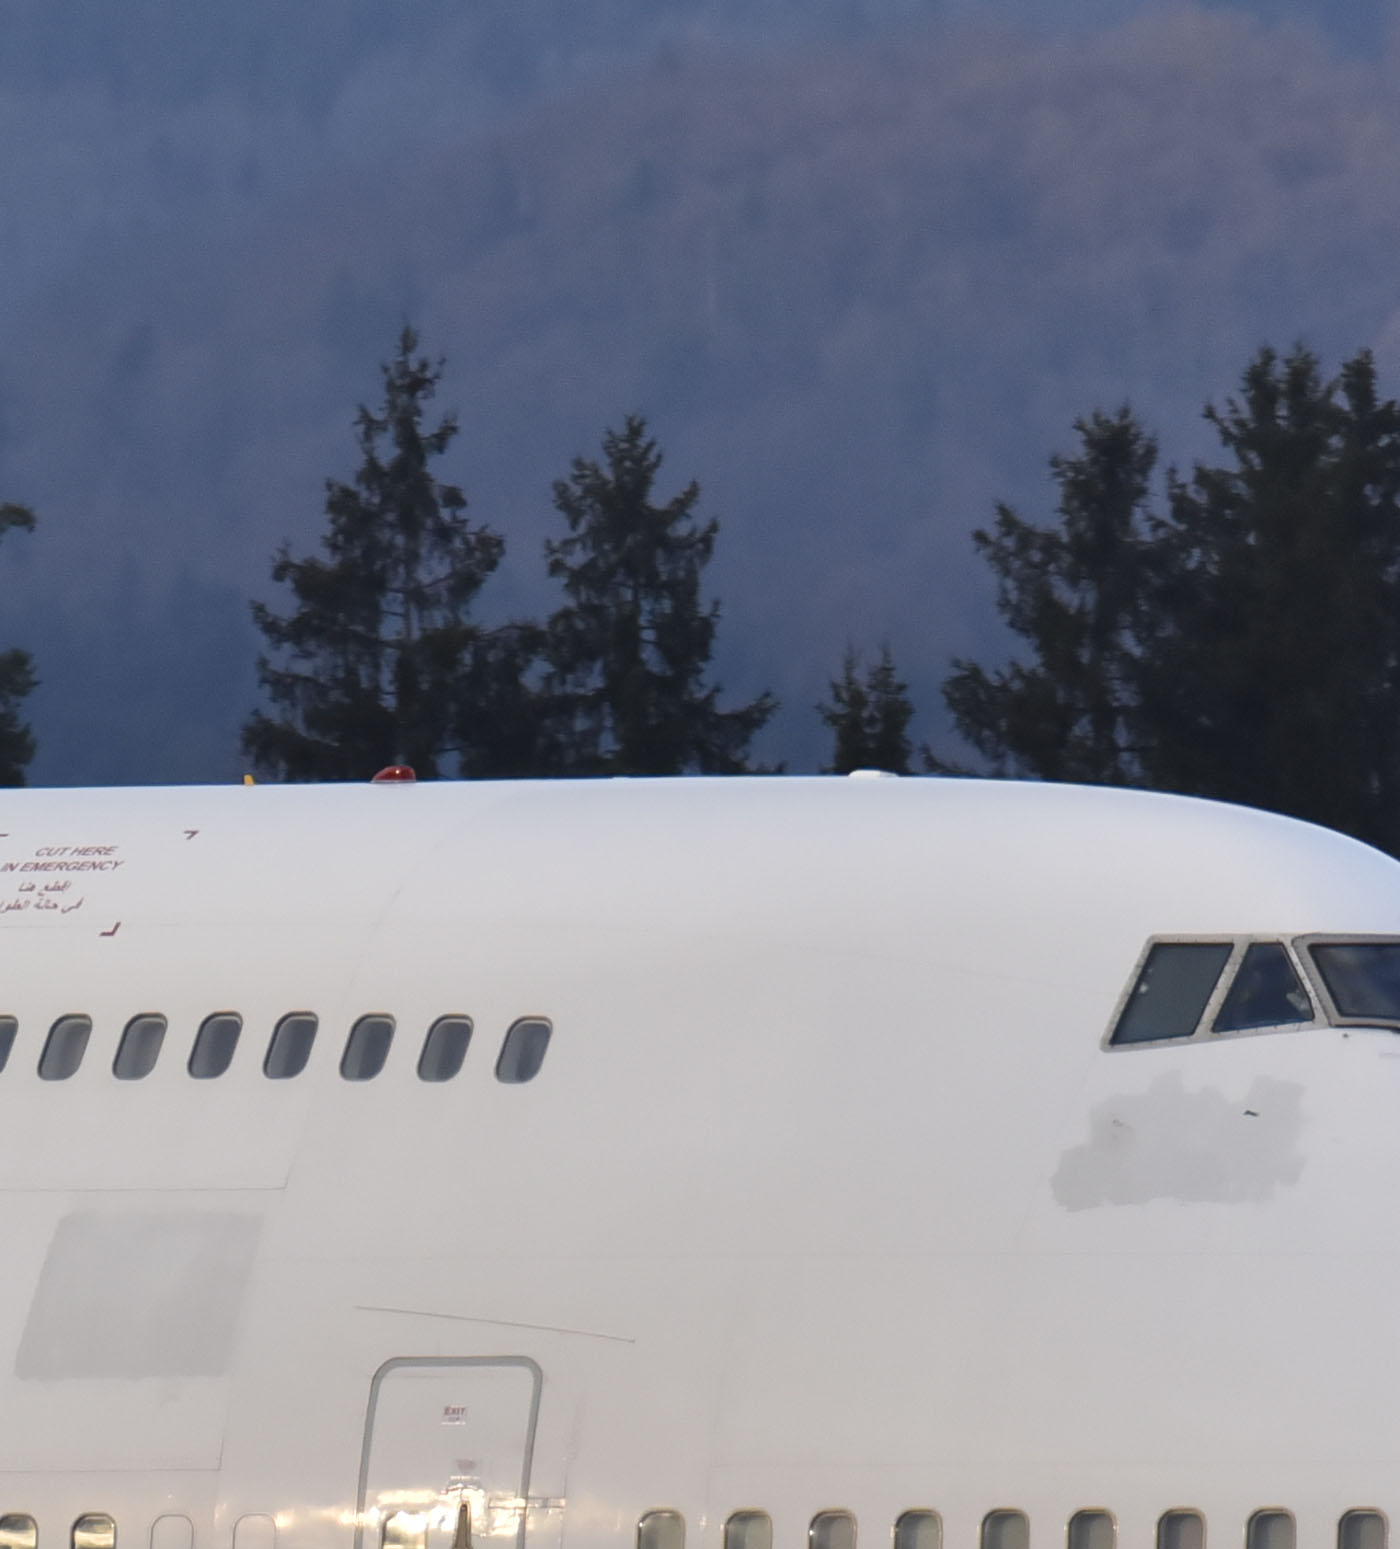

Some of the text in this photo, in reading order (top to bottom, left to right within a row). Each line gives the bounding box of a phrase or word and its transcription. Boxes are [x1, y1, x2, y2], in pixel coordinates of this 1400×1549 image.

[35, 846, 119, 857] CUT HERE
[0, 861, 125, 872] IN EMERGENCY
[444, 1406, 466, 1416] EXIT
